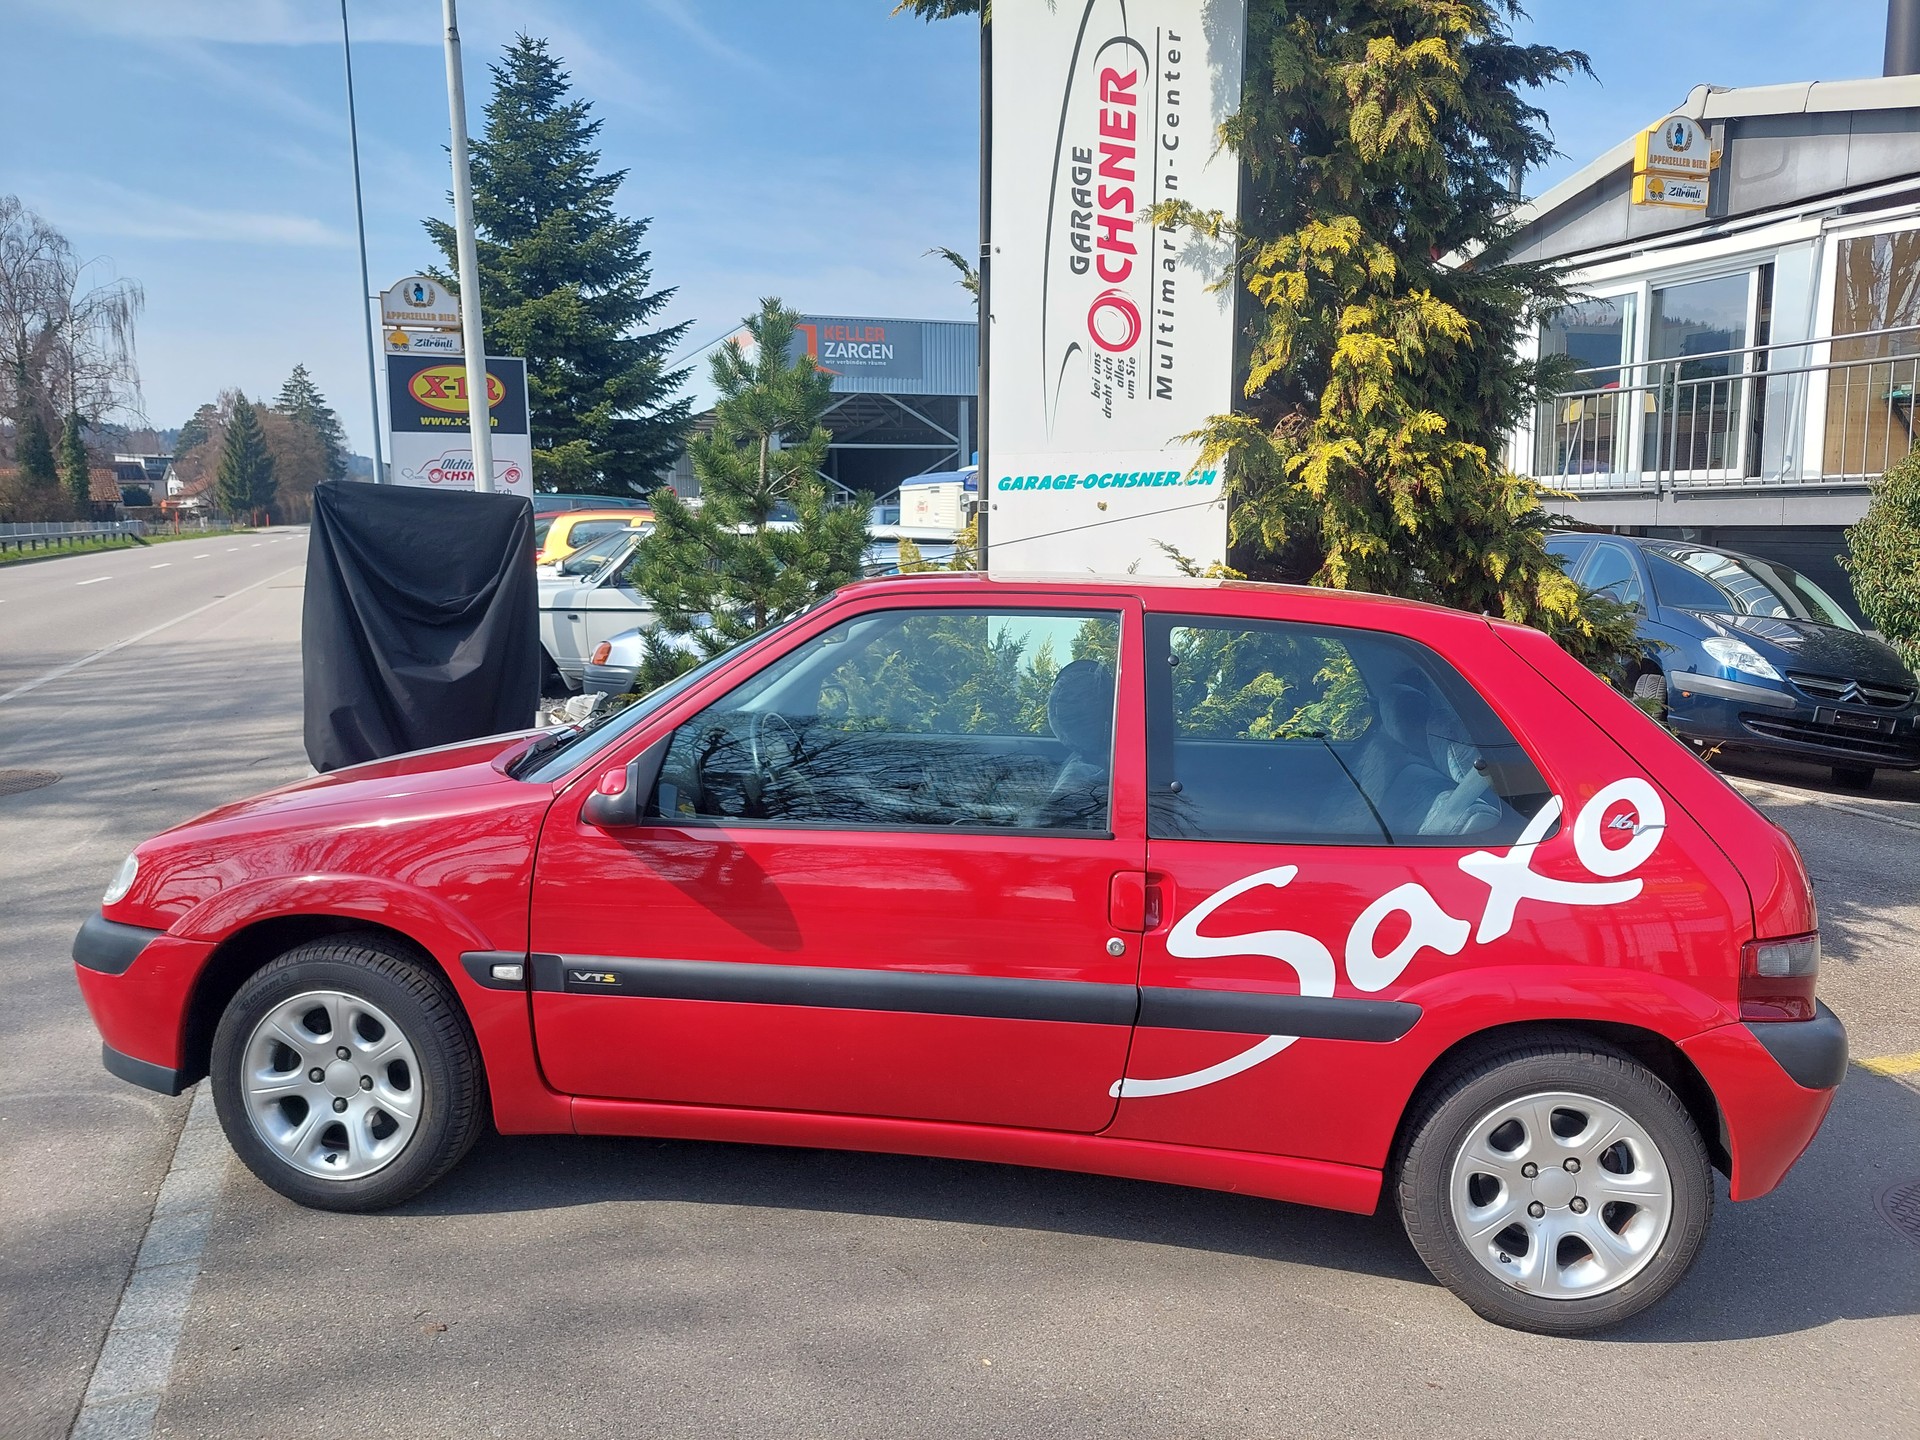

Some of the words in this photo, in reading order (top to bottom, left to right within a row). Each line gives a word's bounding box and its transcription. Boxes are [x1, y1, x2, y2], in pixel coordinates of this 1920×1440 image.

[1650, 154, 1690, 167] APPENZELLER
[1692, 159, 1707, 169] BIER
[1668, 186, 1701, 199] Zitrönli
[1070, 146, 1093, 275] GARAGE
[1087, 67, 1142, 352] OCHSNER
[1156, 30, 1182, 401] Multimarkn-Center
[386, 311, 437, 321] APPENZELLER
[438, 313, 457, 322] BIER
[414, 338, 453, 348] Zitrönli
[824, 325, 885, 343] KELLER
[824, 341, 894, 360] ZARGEN
[1102, 357, 1113, 382] sich
[1113, 358, 1125, 389] alles
[1126, 356, 1136, 377] Sie
[421, 375, 500, 401] X-1R
[1090, 376, 1101, 399] bei
[1127, 379, 1135, 400] um
[1101, 384, 1113, 419] dreht
[997, 469, 1218, 491] GARAGE-OCHSNER.CH
[1109, 777, 1667, 1098] Saxo
[574, 971, 616, 983] VTS
